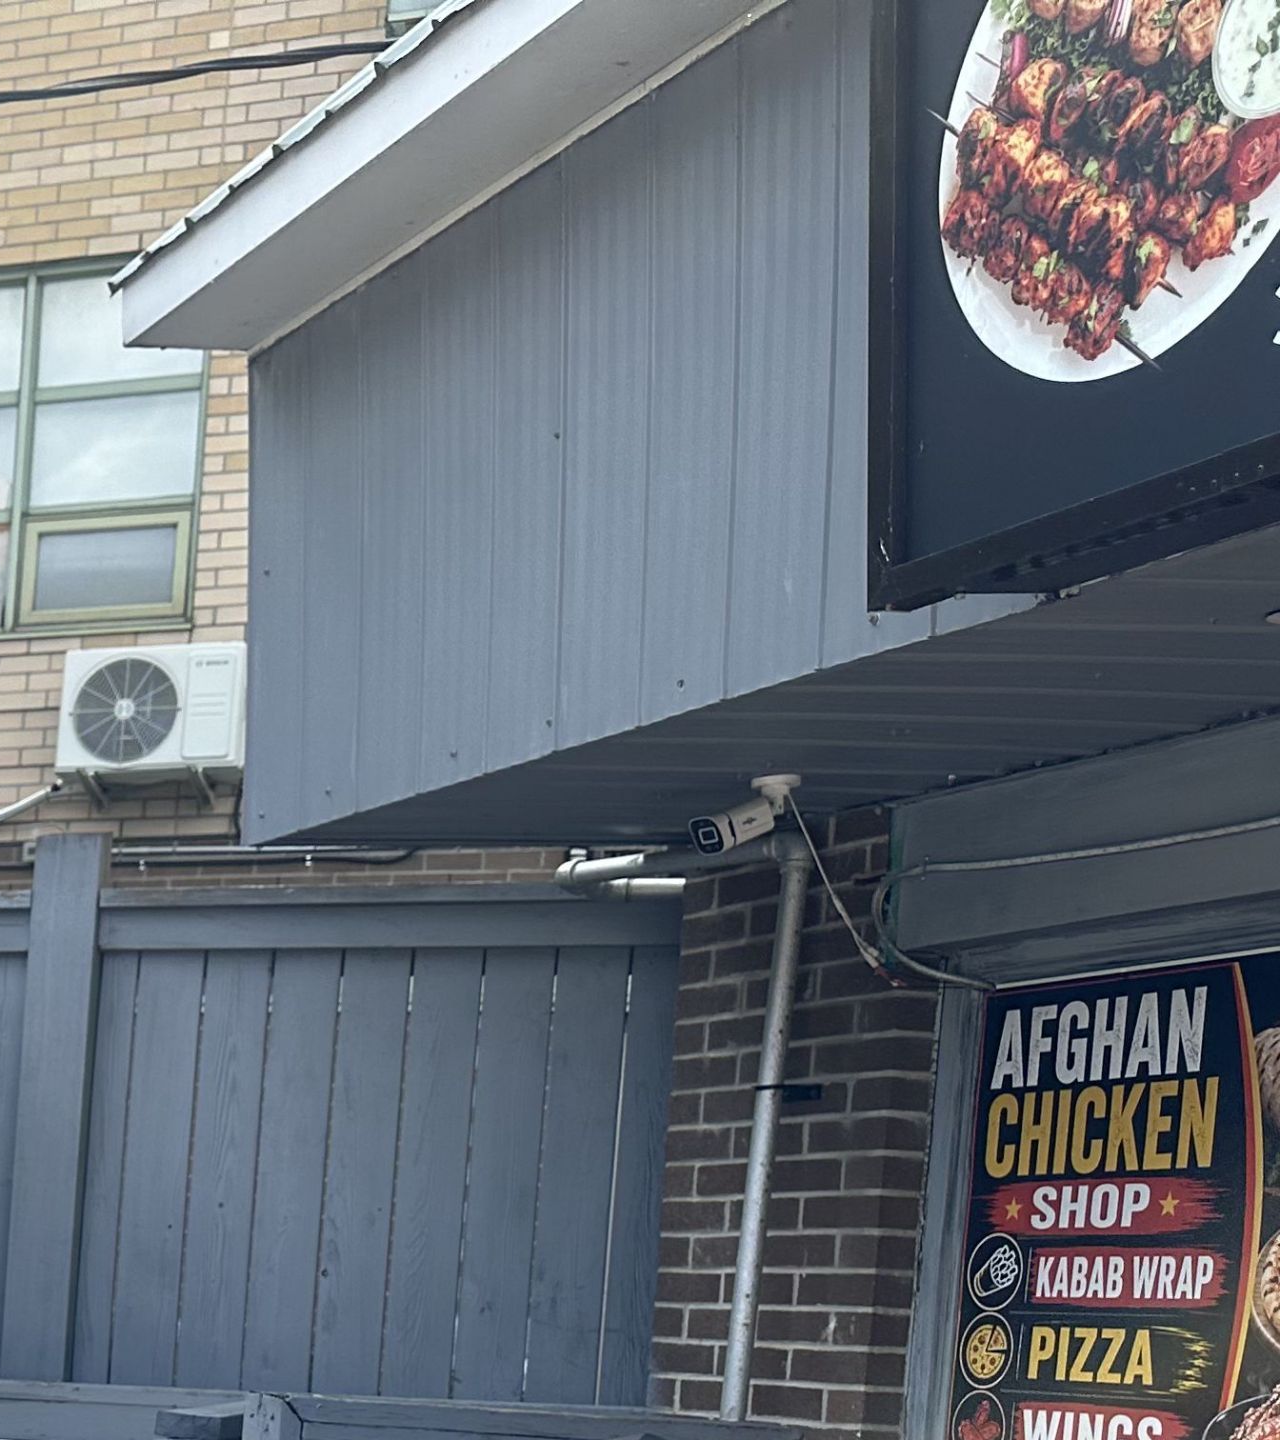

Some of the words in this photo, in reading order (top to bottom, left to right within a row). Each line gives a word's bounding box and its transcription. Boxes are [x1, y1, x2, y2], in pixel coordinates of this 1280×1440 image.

[990, 986, 1208, 1090] AFGHAN
[985, 1076, 1220, 1178] CHICKEN
[1030, 1182, 1151, 1230] SHOP
[1035, 1258, 1124, 1299] KABAB
[1133, 1255, 1214, 1300] WRAP
[1027, 1327, 1154, 1385] PIZZA
